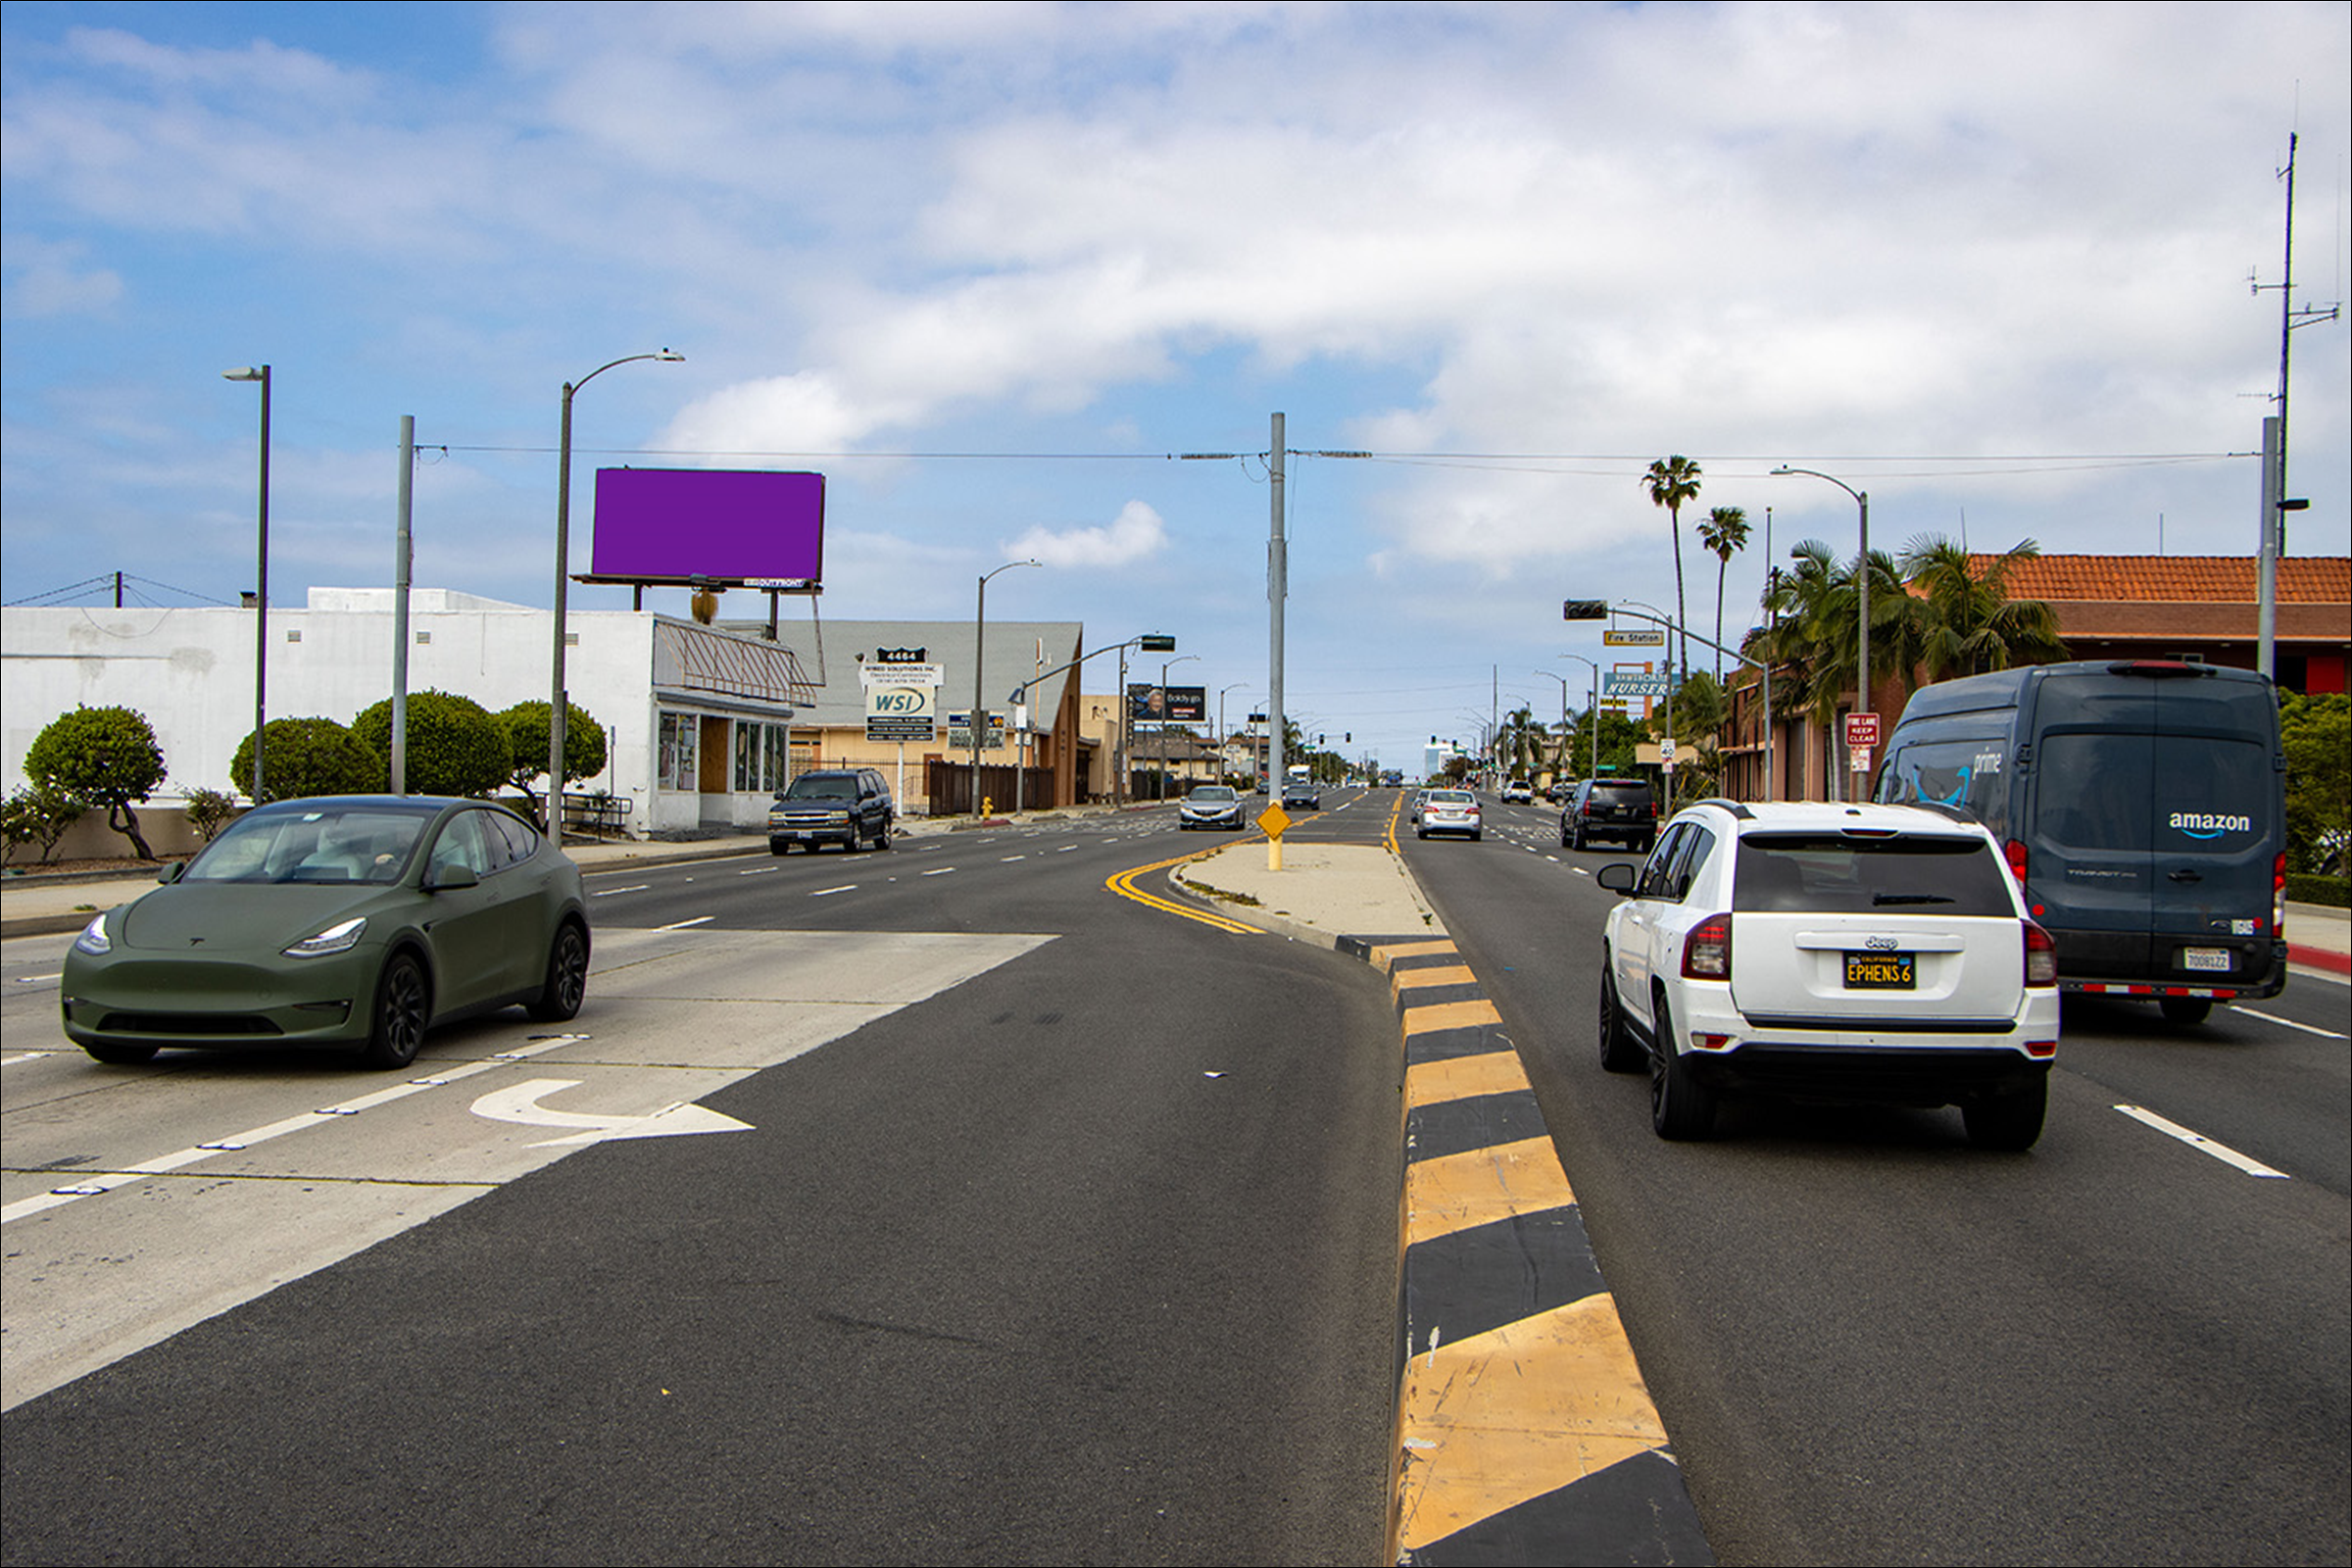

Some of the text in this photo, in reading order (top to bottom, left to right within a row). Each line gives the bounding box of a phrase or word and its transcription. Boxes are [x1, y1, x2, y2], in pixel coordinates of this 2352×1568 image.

[1608, 633, 1660, 642] Fire Station
[876, 695, 912, 710] WSI
[1661, 748, 1675, 757] 40
[1972, 746, 2002, 781] prime
[2169, 811, 2251, 832] amazon
[1865, 935, 1899, 952] Jeep
